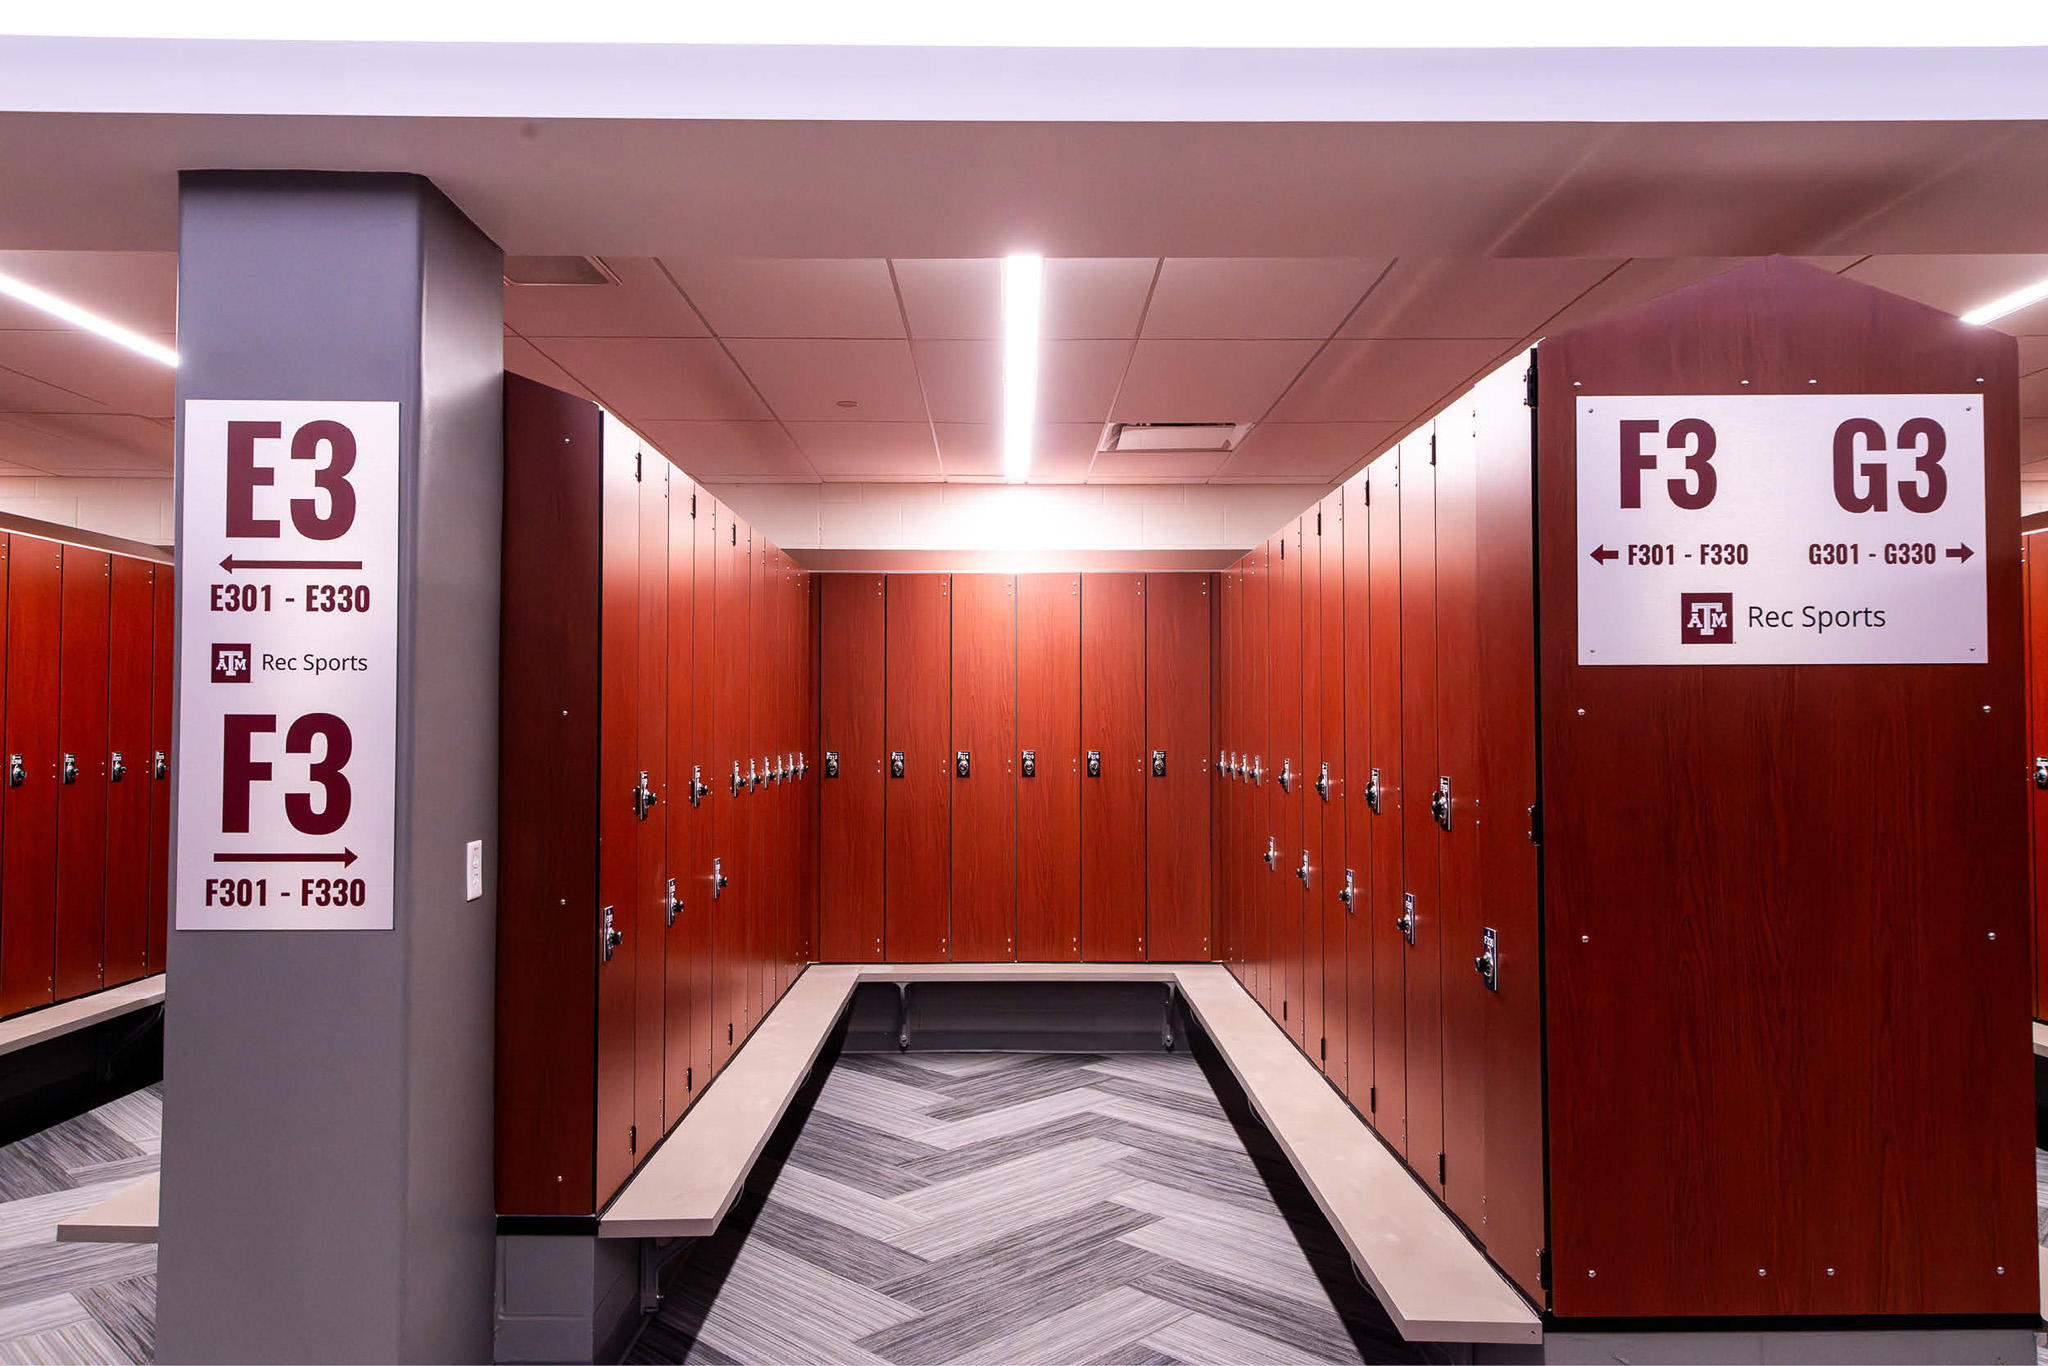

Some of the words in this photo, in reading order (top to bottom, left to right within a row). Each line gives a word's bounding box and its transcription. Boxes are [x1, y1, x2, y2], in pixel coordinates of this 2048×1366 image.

[1619, 417, 1718, 511] F3
[1832, 417, 1948, 514] G3
[225, 419, 357, 541] E3
[1628, 543, 1674, 566] F301
[1700, 543, 1749, 566] F330
[1808, 543, 1859, 565] G301
[1884, 542, 1936, 565] G330
[210, 583, 272, 613] E301
[305, 584, 370, 613] E330
[1748, 606, 1794, 628] Rec
[1802, 605, 1886, 635] Sports
[262, 653, 297, 671] Rec
[303, 653, 368, 676] Sports
[221, 712, 353, 836] F3
[205, 878, 267, 907] F301
[301, 878, 366, 907] F330
